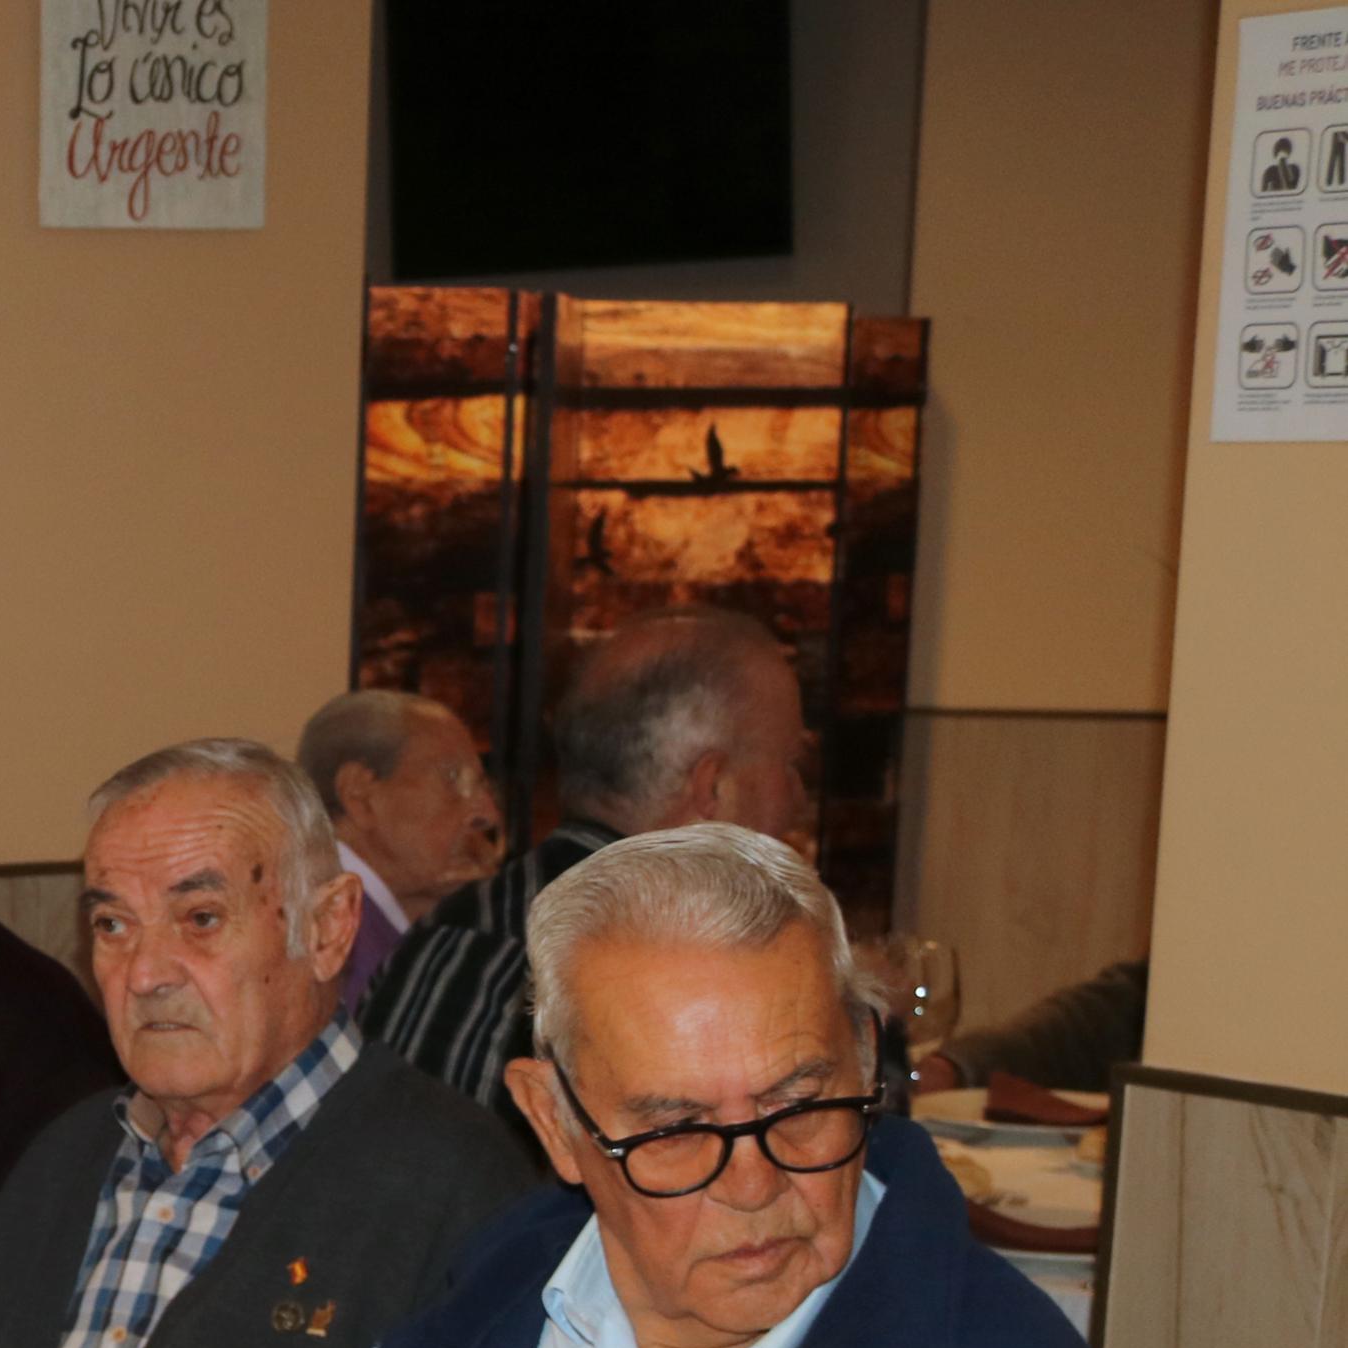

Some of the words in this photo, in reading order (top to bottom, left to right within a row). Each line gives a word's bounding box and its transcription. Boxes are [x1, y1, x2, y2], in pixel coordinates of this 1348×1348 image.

[195, 0, 235, 46] es
[1292, 31, 1342, 51] FRENTE
[69, 29, 116, 120] Lo
[128, 42, 246, 107] único
[1256, 92, 1306, 112] BUENAS
[67, 110, 242, 222] Urgente
